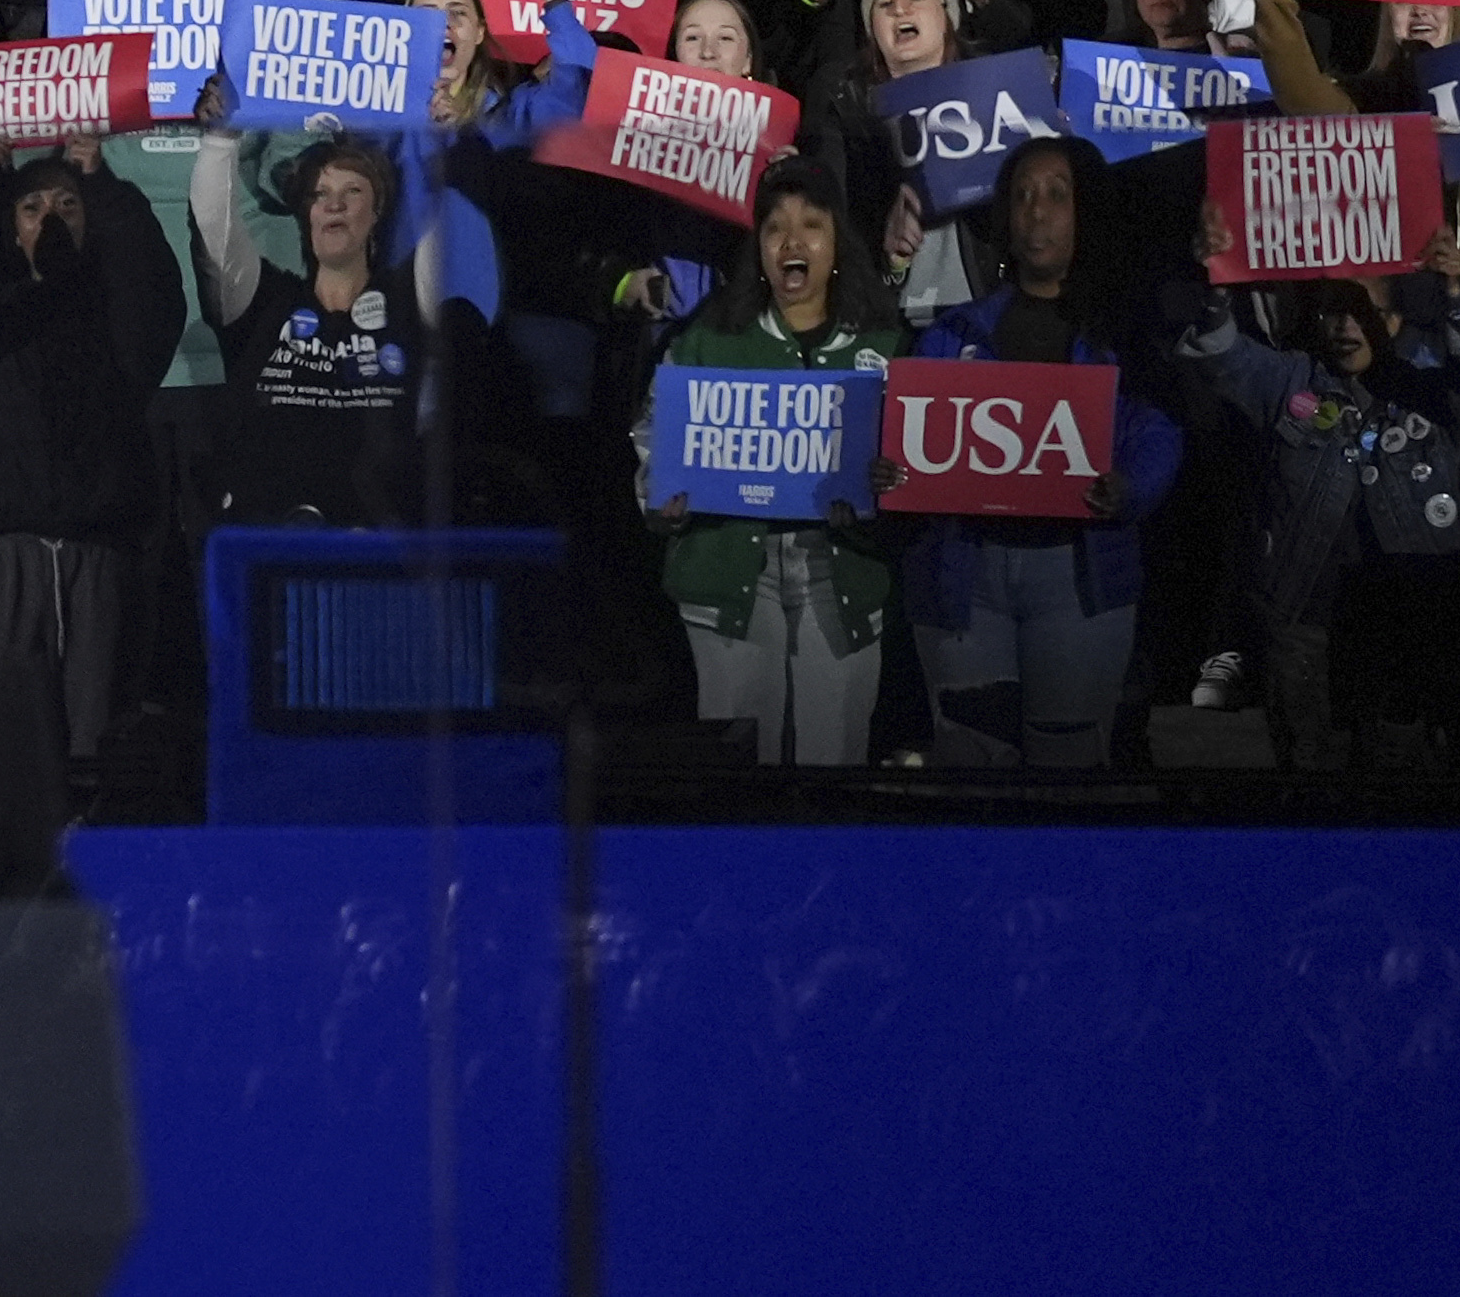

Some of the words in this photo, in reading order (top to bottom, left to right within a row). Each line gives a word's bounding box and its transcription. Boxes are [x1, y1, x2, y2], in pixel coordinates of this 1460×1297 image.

[254, 5, 334, 57] VOTE
[343, 15, 410, 65] FOR
[247, 52, 406, 112] FREEDOM
[689, 380, 769, 427] VOTE
[778, 384, 847, 427] FOR
[684, 424, 842, 473] FREEDOM
[897, 396, 1098, 476] USA
